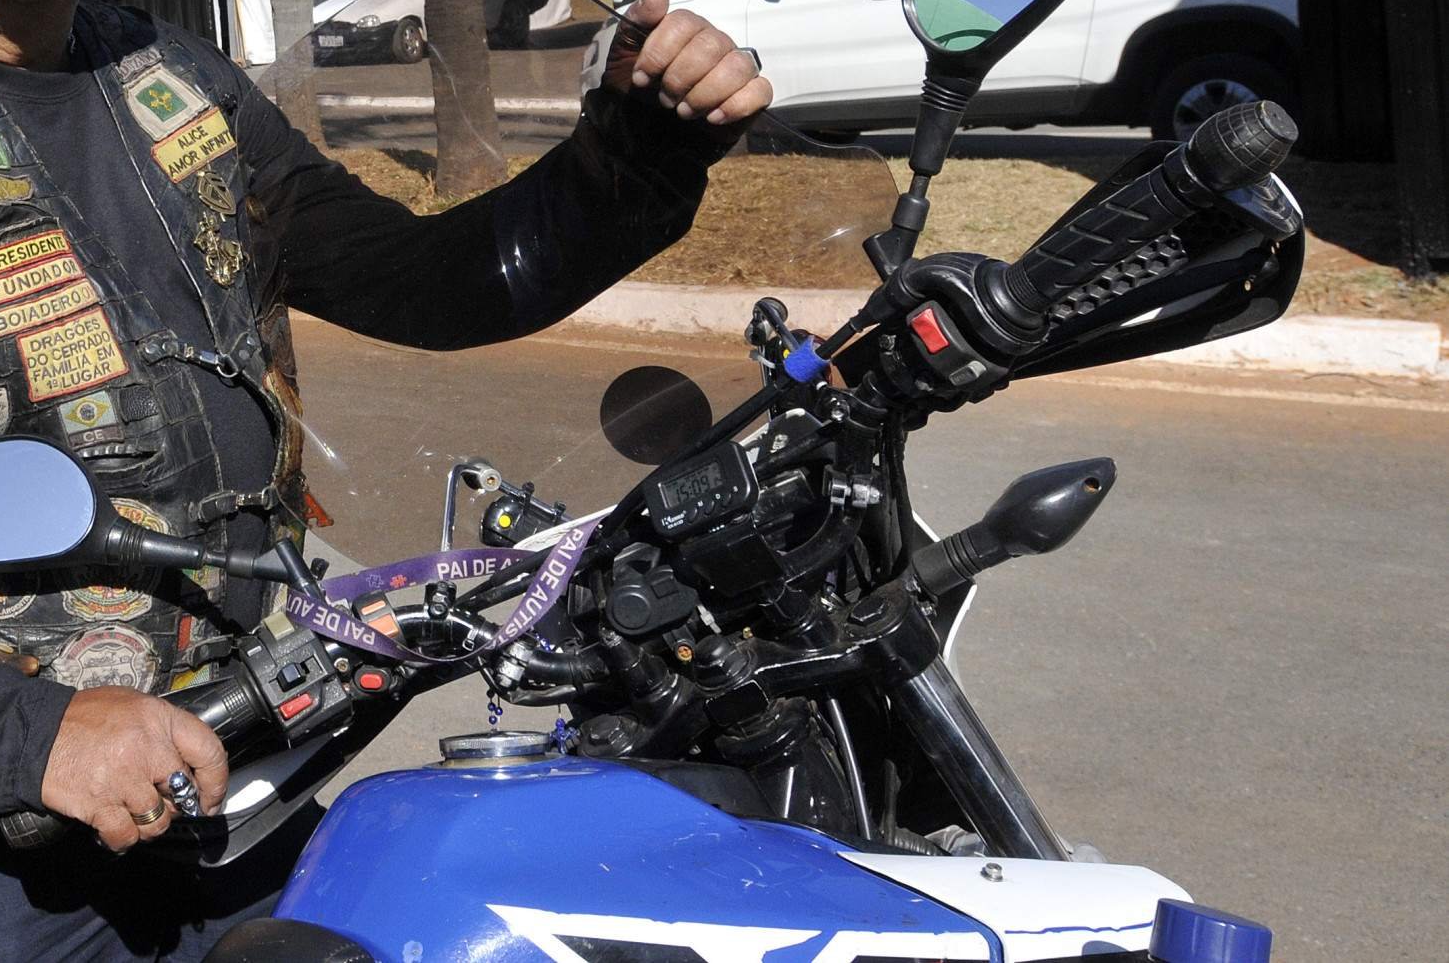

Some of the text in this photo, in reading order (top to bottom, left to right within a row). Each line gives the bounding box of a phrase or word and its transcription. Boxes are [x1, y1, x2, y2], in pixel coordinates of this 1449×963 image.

[177, 125, 208, 150] ALICE
[167, 130, 231, 178] AMOR INFINIT
[28, 331, 110, 368] DO CERRADO
[96, 344, 115, 362] EM
[62, 362, 111, 388] LUGAR
[82, 430, 103, 443] CE
[561, 529, 584, 560] PAI
[437, 562, 467, 580] PAI
[473, 558, 496, 576] DE
[541, 560, 566, 589] DE
[313, 606, 341, 632] DE
[344, 620, 376, 645] PAI
